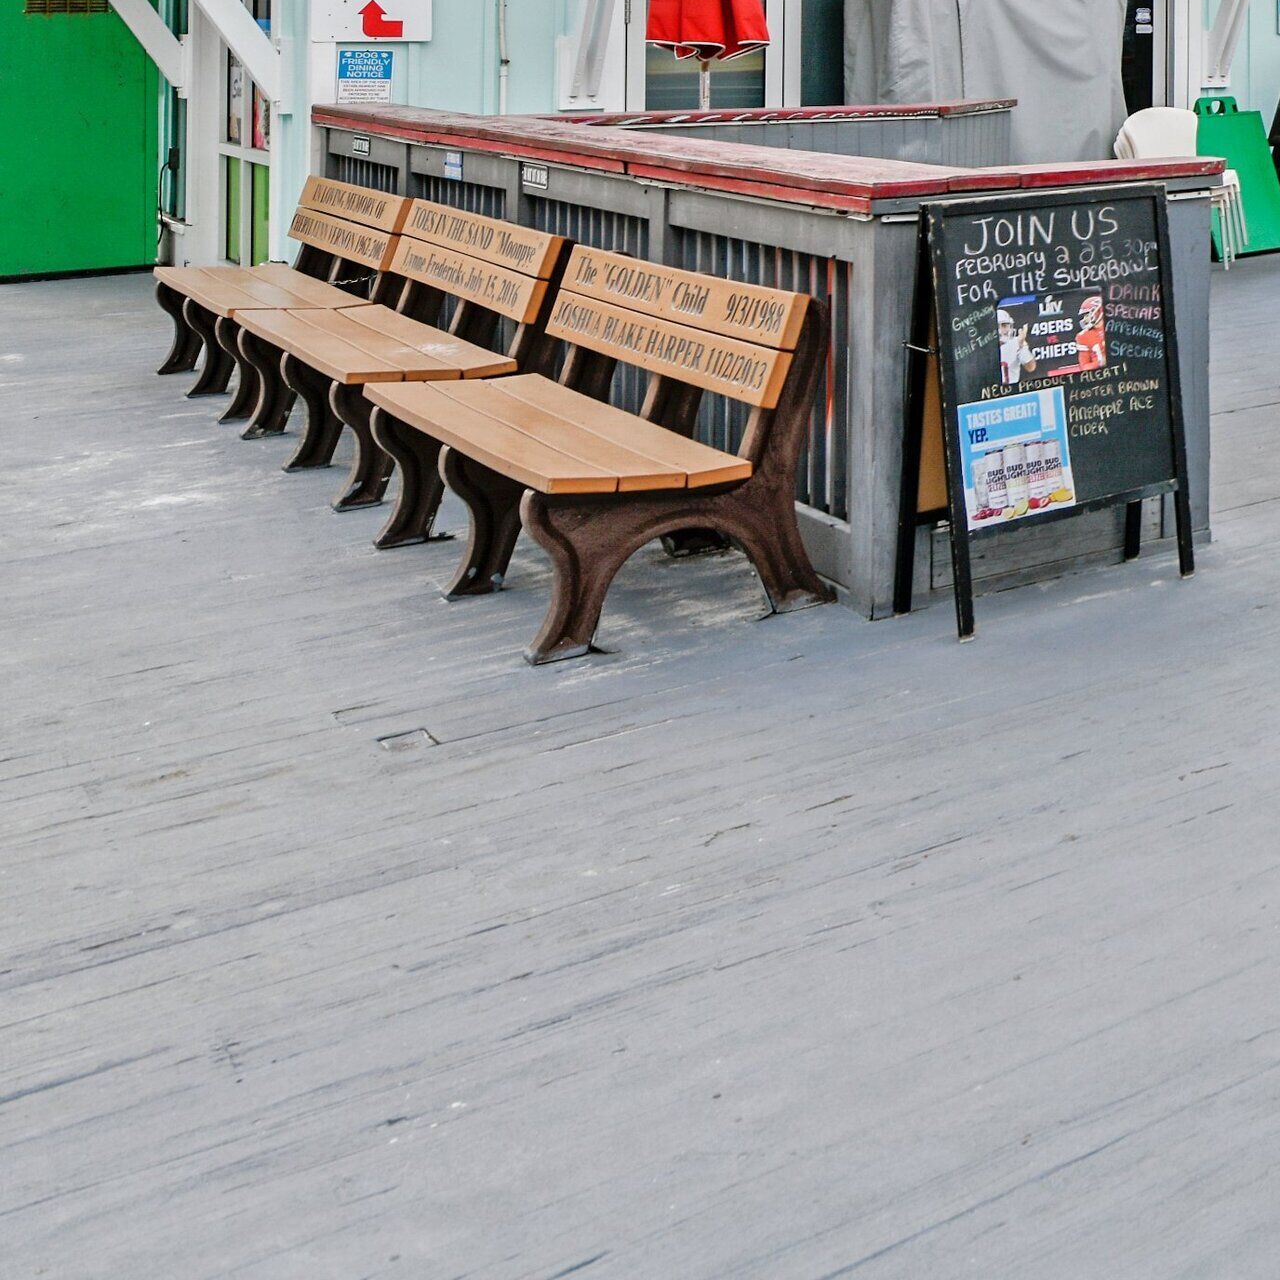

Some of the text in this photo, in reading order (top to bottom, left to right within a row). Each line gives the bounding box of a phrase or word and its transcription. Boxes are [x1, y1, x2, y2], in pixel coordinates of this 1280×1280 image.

[342, 58, 390, 66] FRIENDLY
[410, 206, 436, 233] TOES
[434, 214, 447, 236] IN
[446, 216, 469, 241] THE
[466, 223, 495, 250] SAND
[964, 207, 1119, 256] JOIN US
[574, 254, 786, 334] The "GOLDEN" Child 9/3/1988
[957, 278, 999, 306] FOR
[1008, 270, 1049, 294] THE
[1031, 317, 1074, 336] 49ERS
[553, 300, 769, 392] JOSHUA BLAKE HARPER 11/2/2013
[1031, 341, 1079, 361] CHIEFS
[1018, 374, 1074, 393] PRODUCT
[1069, 378, 1160, 402] HOOTER BROWN
[1129, 395, 1154, 411] ACE
[966, 402, 1038, 429] TASTES GREAT?
[968, 427, 989, 444] YEP.
[1070, 422, 1109, 438] CIDER
